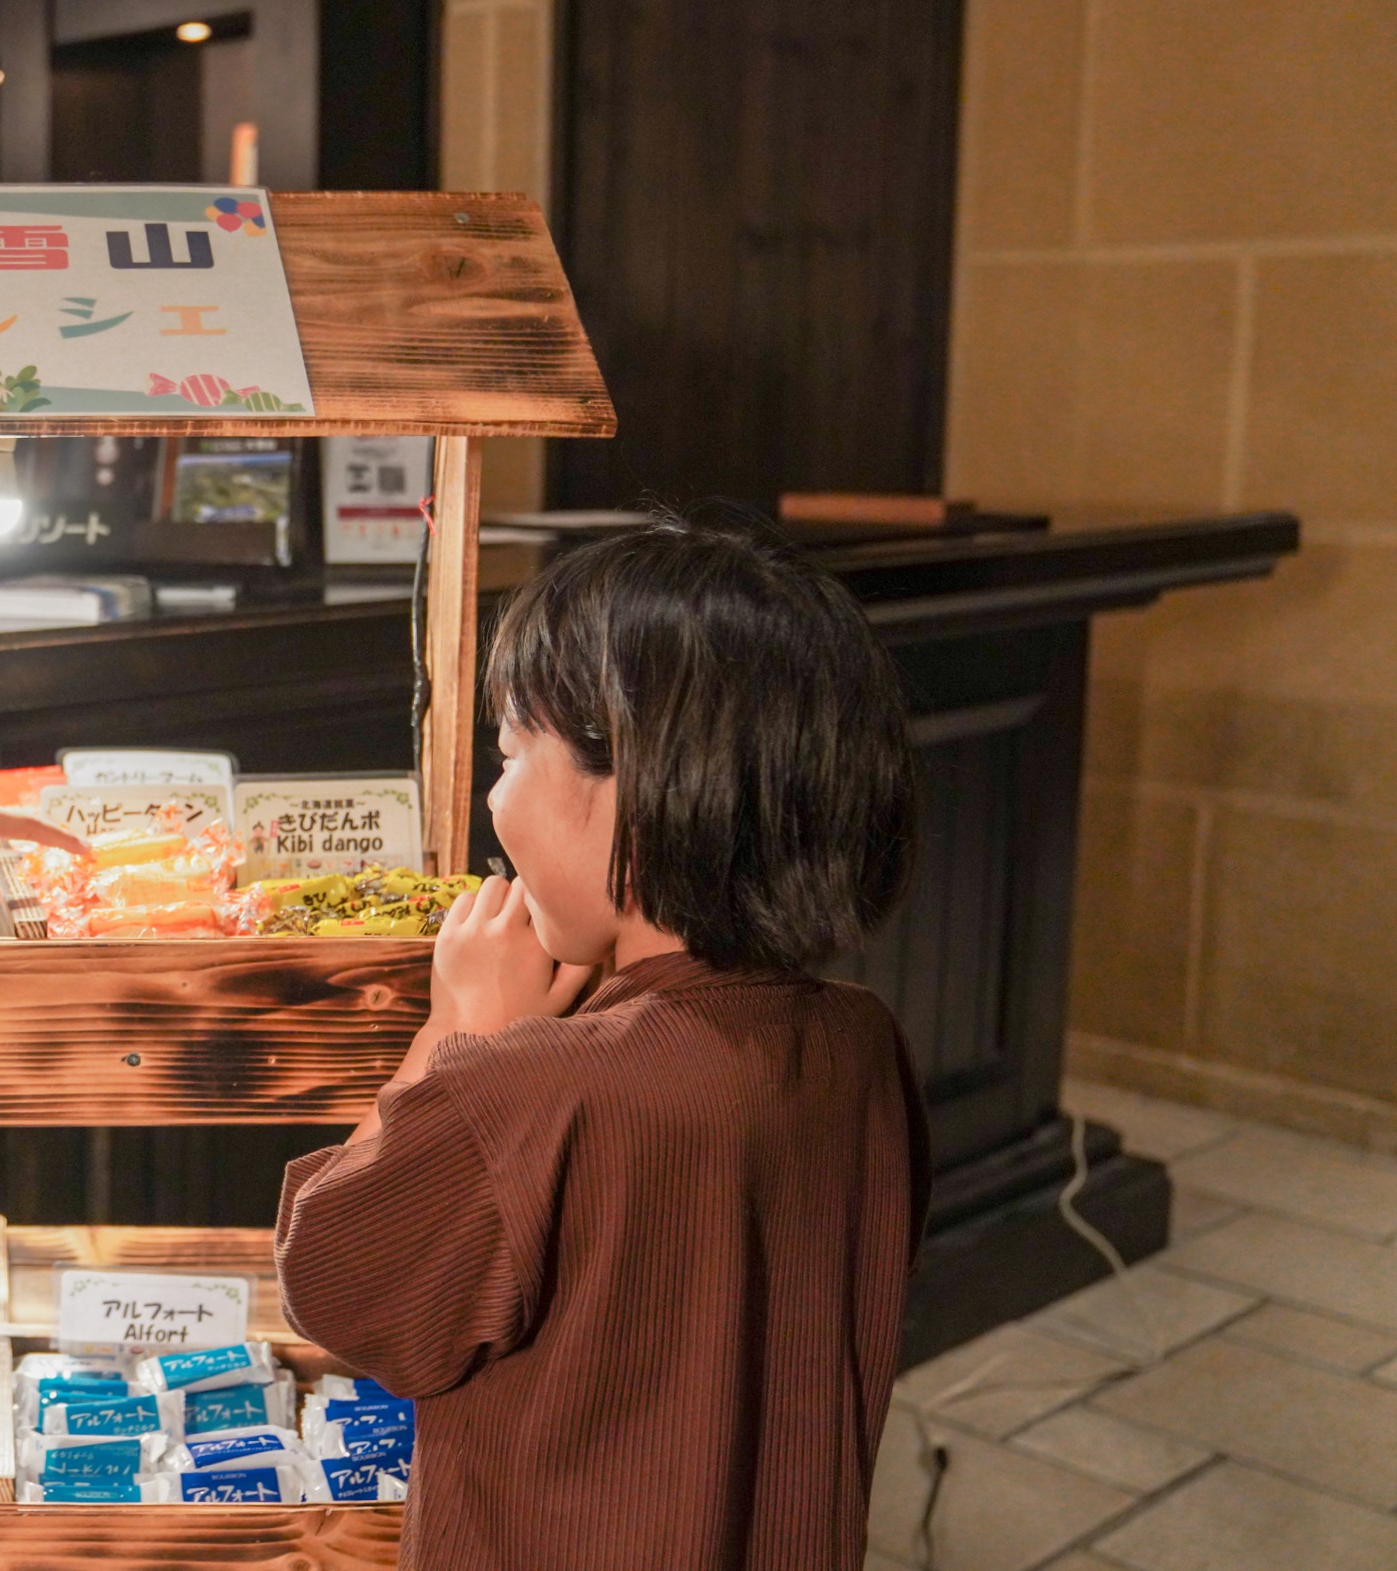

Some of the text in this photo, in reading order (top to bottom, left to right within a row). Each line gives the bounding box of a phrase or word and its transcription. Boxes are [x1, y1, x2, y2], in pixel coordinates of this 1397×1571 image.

[276, 833, 384, 854] Kibi dango
[102, 1299, 215, 1322] アルフォート
[124, 1322, 190, 1344] Alfort
[70, 1406, 157, 1429] アルフォート
[191, 1436, 280, 1453] アルフォート
